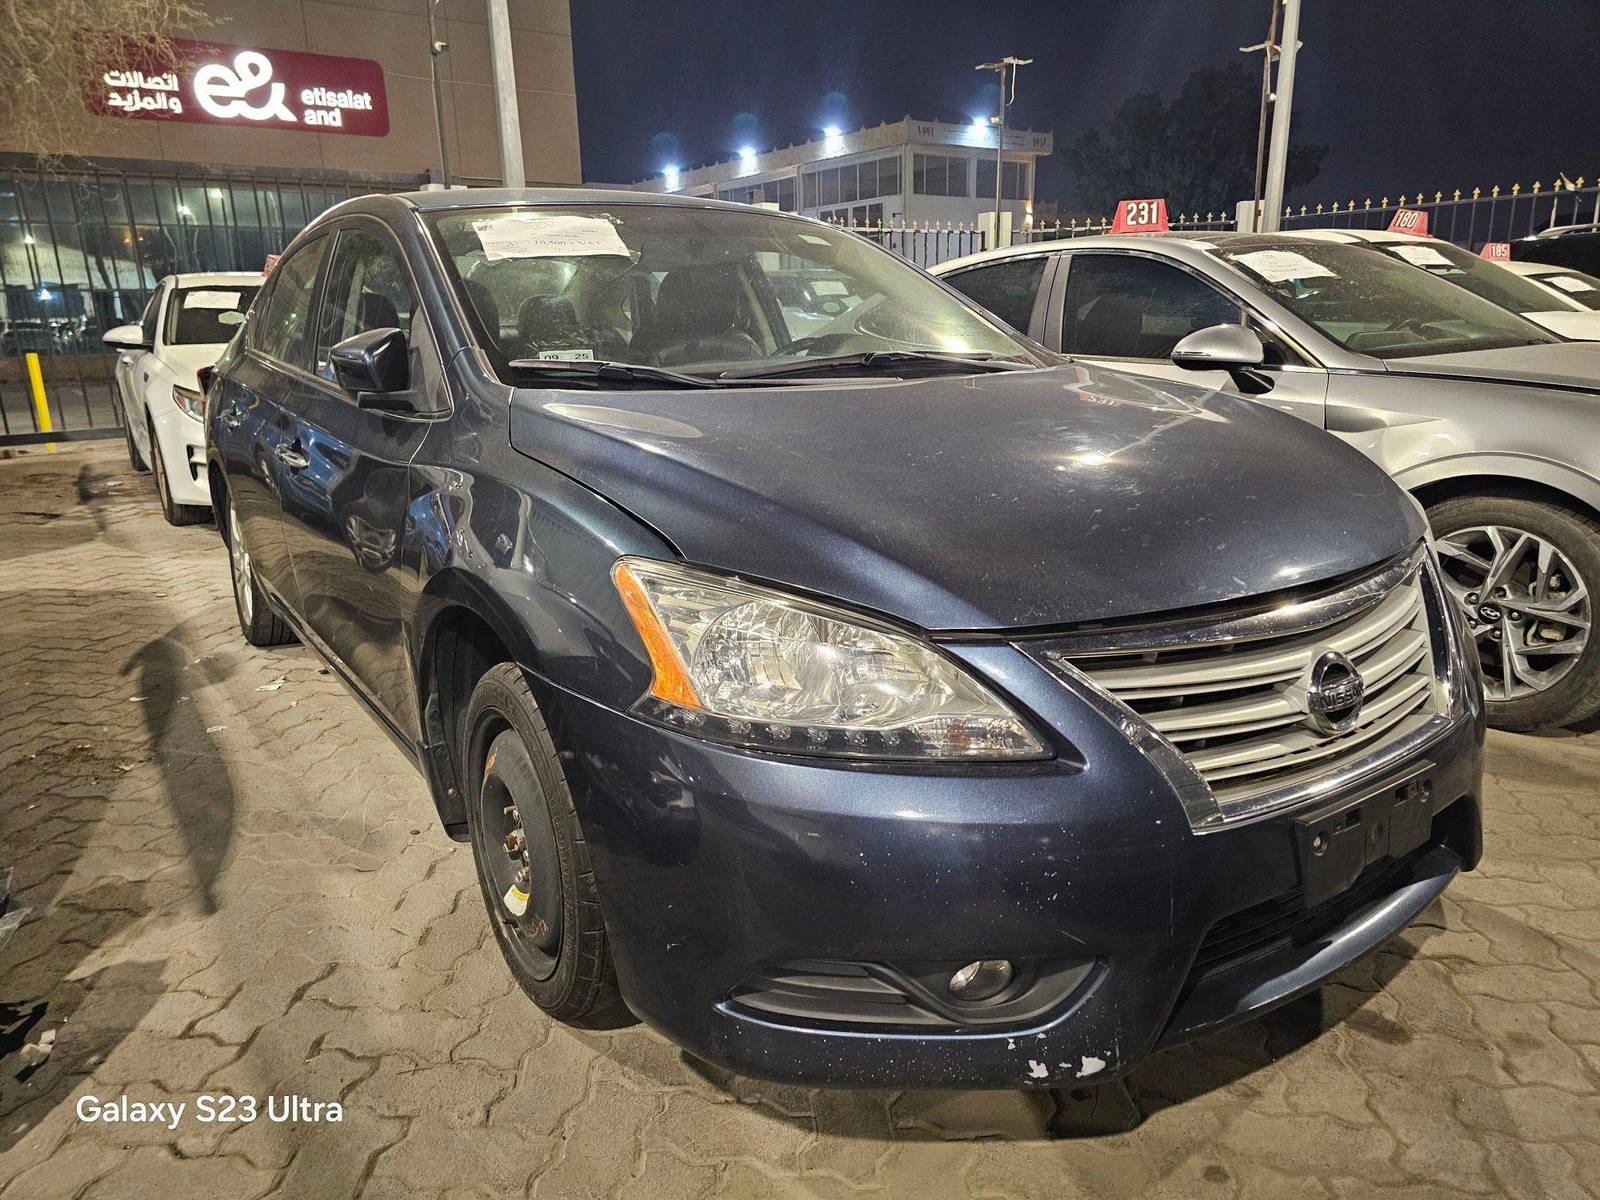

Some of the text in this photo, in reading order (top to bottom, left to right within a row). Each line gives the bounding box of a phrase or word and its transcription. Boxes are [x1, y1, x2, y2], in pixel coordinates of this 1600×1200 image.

[301, 87, 372, 110] etisalat
[305, 108, 342, 127] and
[1126, 201, 1158, 225] 231
[1395, 211, 1419, 228] 180
[1491, 245, 1507, 257] 185
